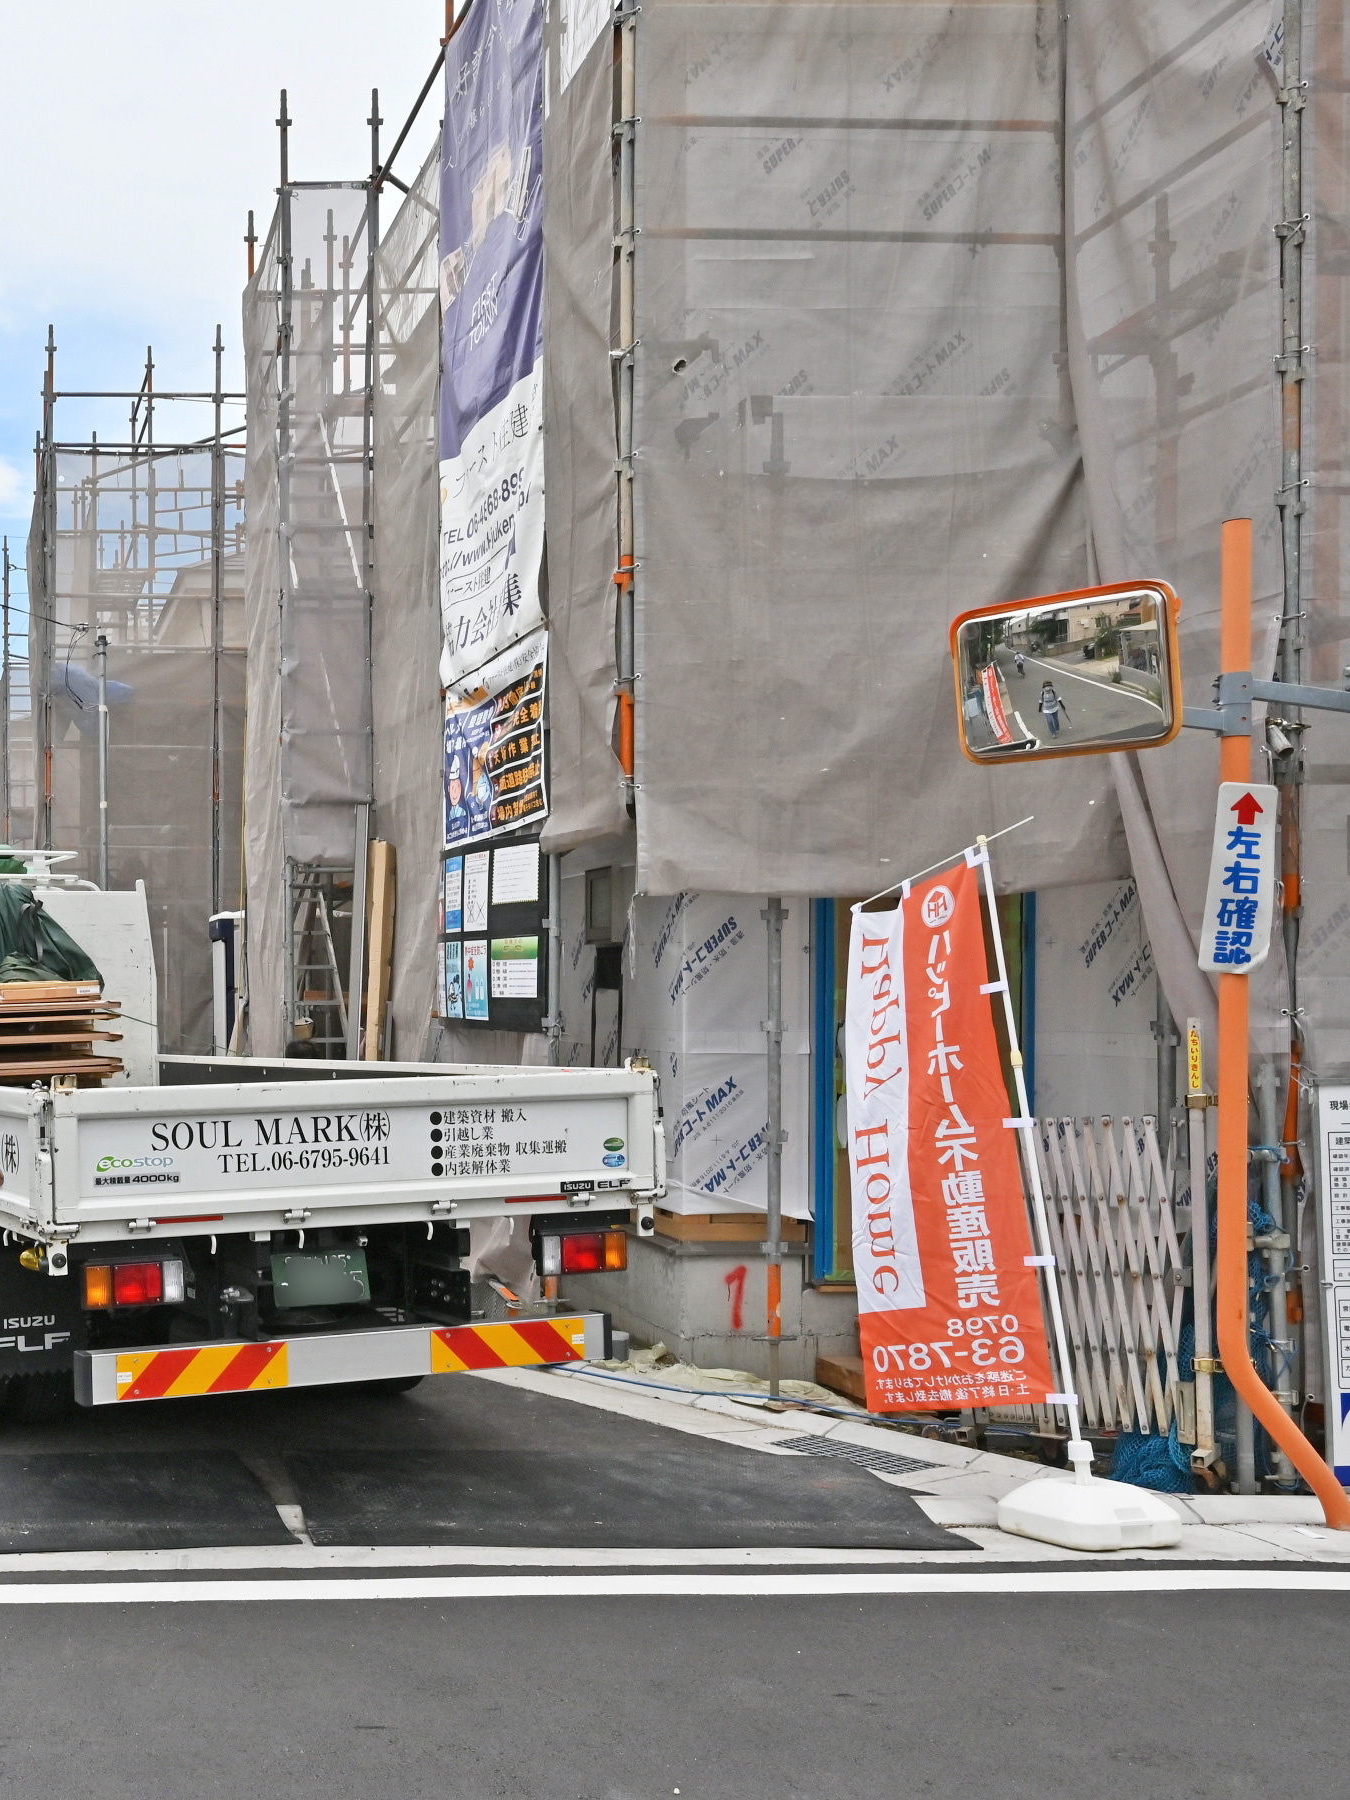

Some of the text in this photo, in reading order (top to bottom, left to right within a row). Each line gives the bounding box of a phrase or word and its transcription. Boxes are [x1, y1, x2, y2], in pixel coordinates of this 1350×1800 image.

[472, 271, 497, 326] FIRST
[469, 299, 499, 351] TOWN
[733, 331, 763, 366] MAX
[935, 331, 966, 366] MAX
[864, 435, 900, 475] MAX
[1213, 826, 1261, 964] 左右確認
[1085, 910, 1121, 968] SUPERコート
[1112, 969, 1135, 1007] MAX
[1190, 1029, 1200, 1089] たちいりきんし
[705, 1075, 738, 1113] MAX
[1329, 1100, 1350, 1111] 現場
[443, 1108, 527, 1125] 建築資材 搬入
[151, 1120, 243, 1152] SOUL
[444, 1126, 494, 1142] 引越し業
[444, 1139, 567, 1159] 産業廃棄物 収集運搬
[96, 1155, 174, 1173] ecostop
[217, 1146, 390, 1174] TEL.06-6795-9641
[445, 1159, 510, 1176] 内装解体業
[564, 1182, 591, 1190] ISUZU
[700, 1168, 727, 1193] MA
[725, 1265, 747, 1329] 1
[3, 1315, 55, 1330] ISUZU
